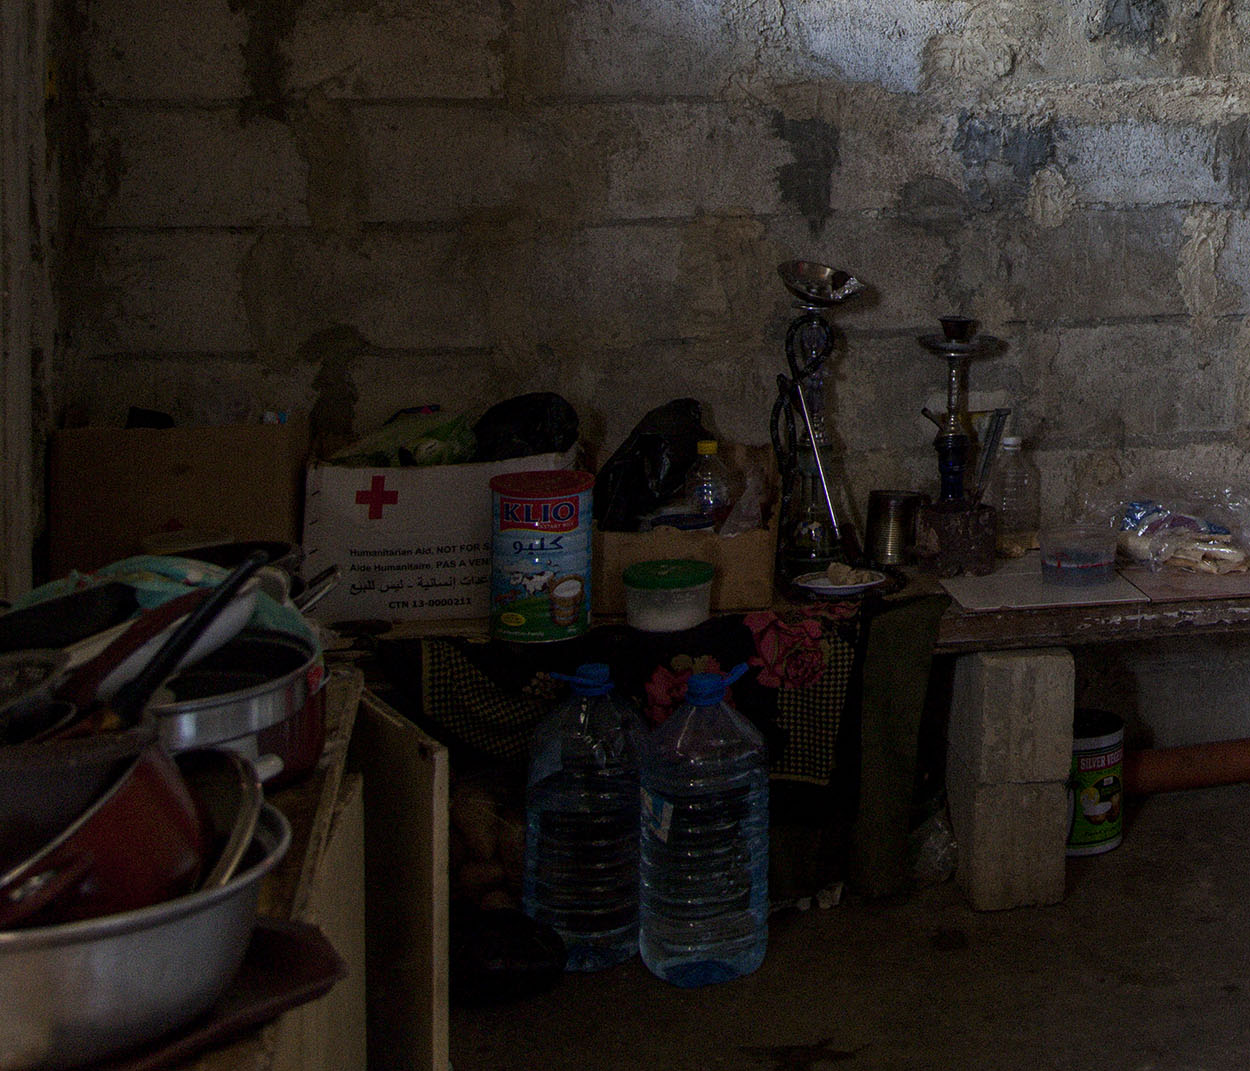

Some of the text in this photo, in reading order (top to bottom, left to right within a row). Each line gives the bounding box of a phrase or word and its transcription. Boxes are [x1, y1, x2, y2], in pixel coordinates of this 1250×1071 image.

[503, 502, 575, 524] KLIO
[350, 548, 413, 557] Humanitarian
[436, 545, 457, 554] NOT
[460, 543, 480, 552] FOR
[483, 542, 491, 551] S
[513, 536, 563, 555] كليو
[350, 564, 371, 572] Aide
[436, 560, 456, 569] PAS
[459, 559, 467, 567] A
[469, 557, 490, 566] VEN
[389, 597, 472, 609] CTN 13-0000211
[1080, 755, 1105, 770] SILVER
